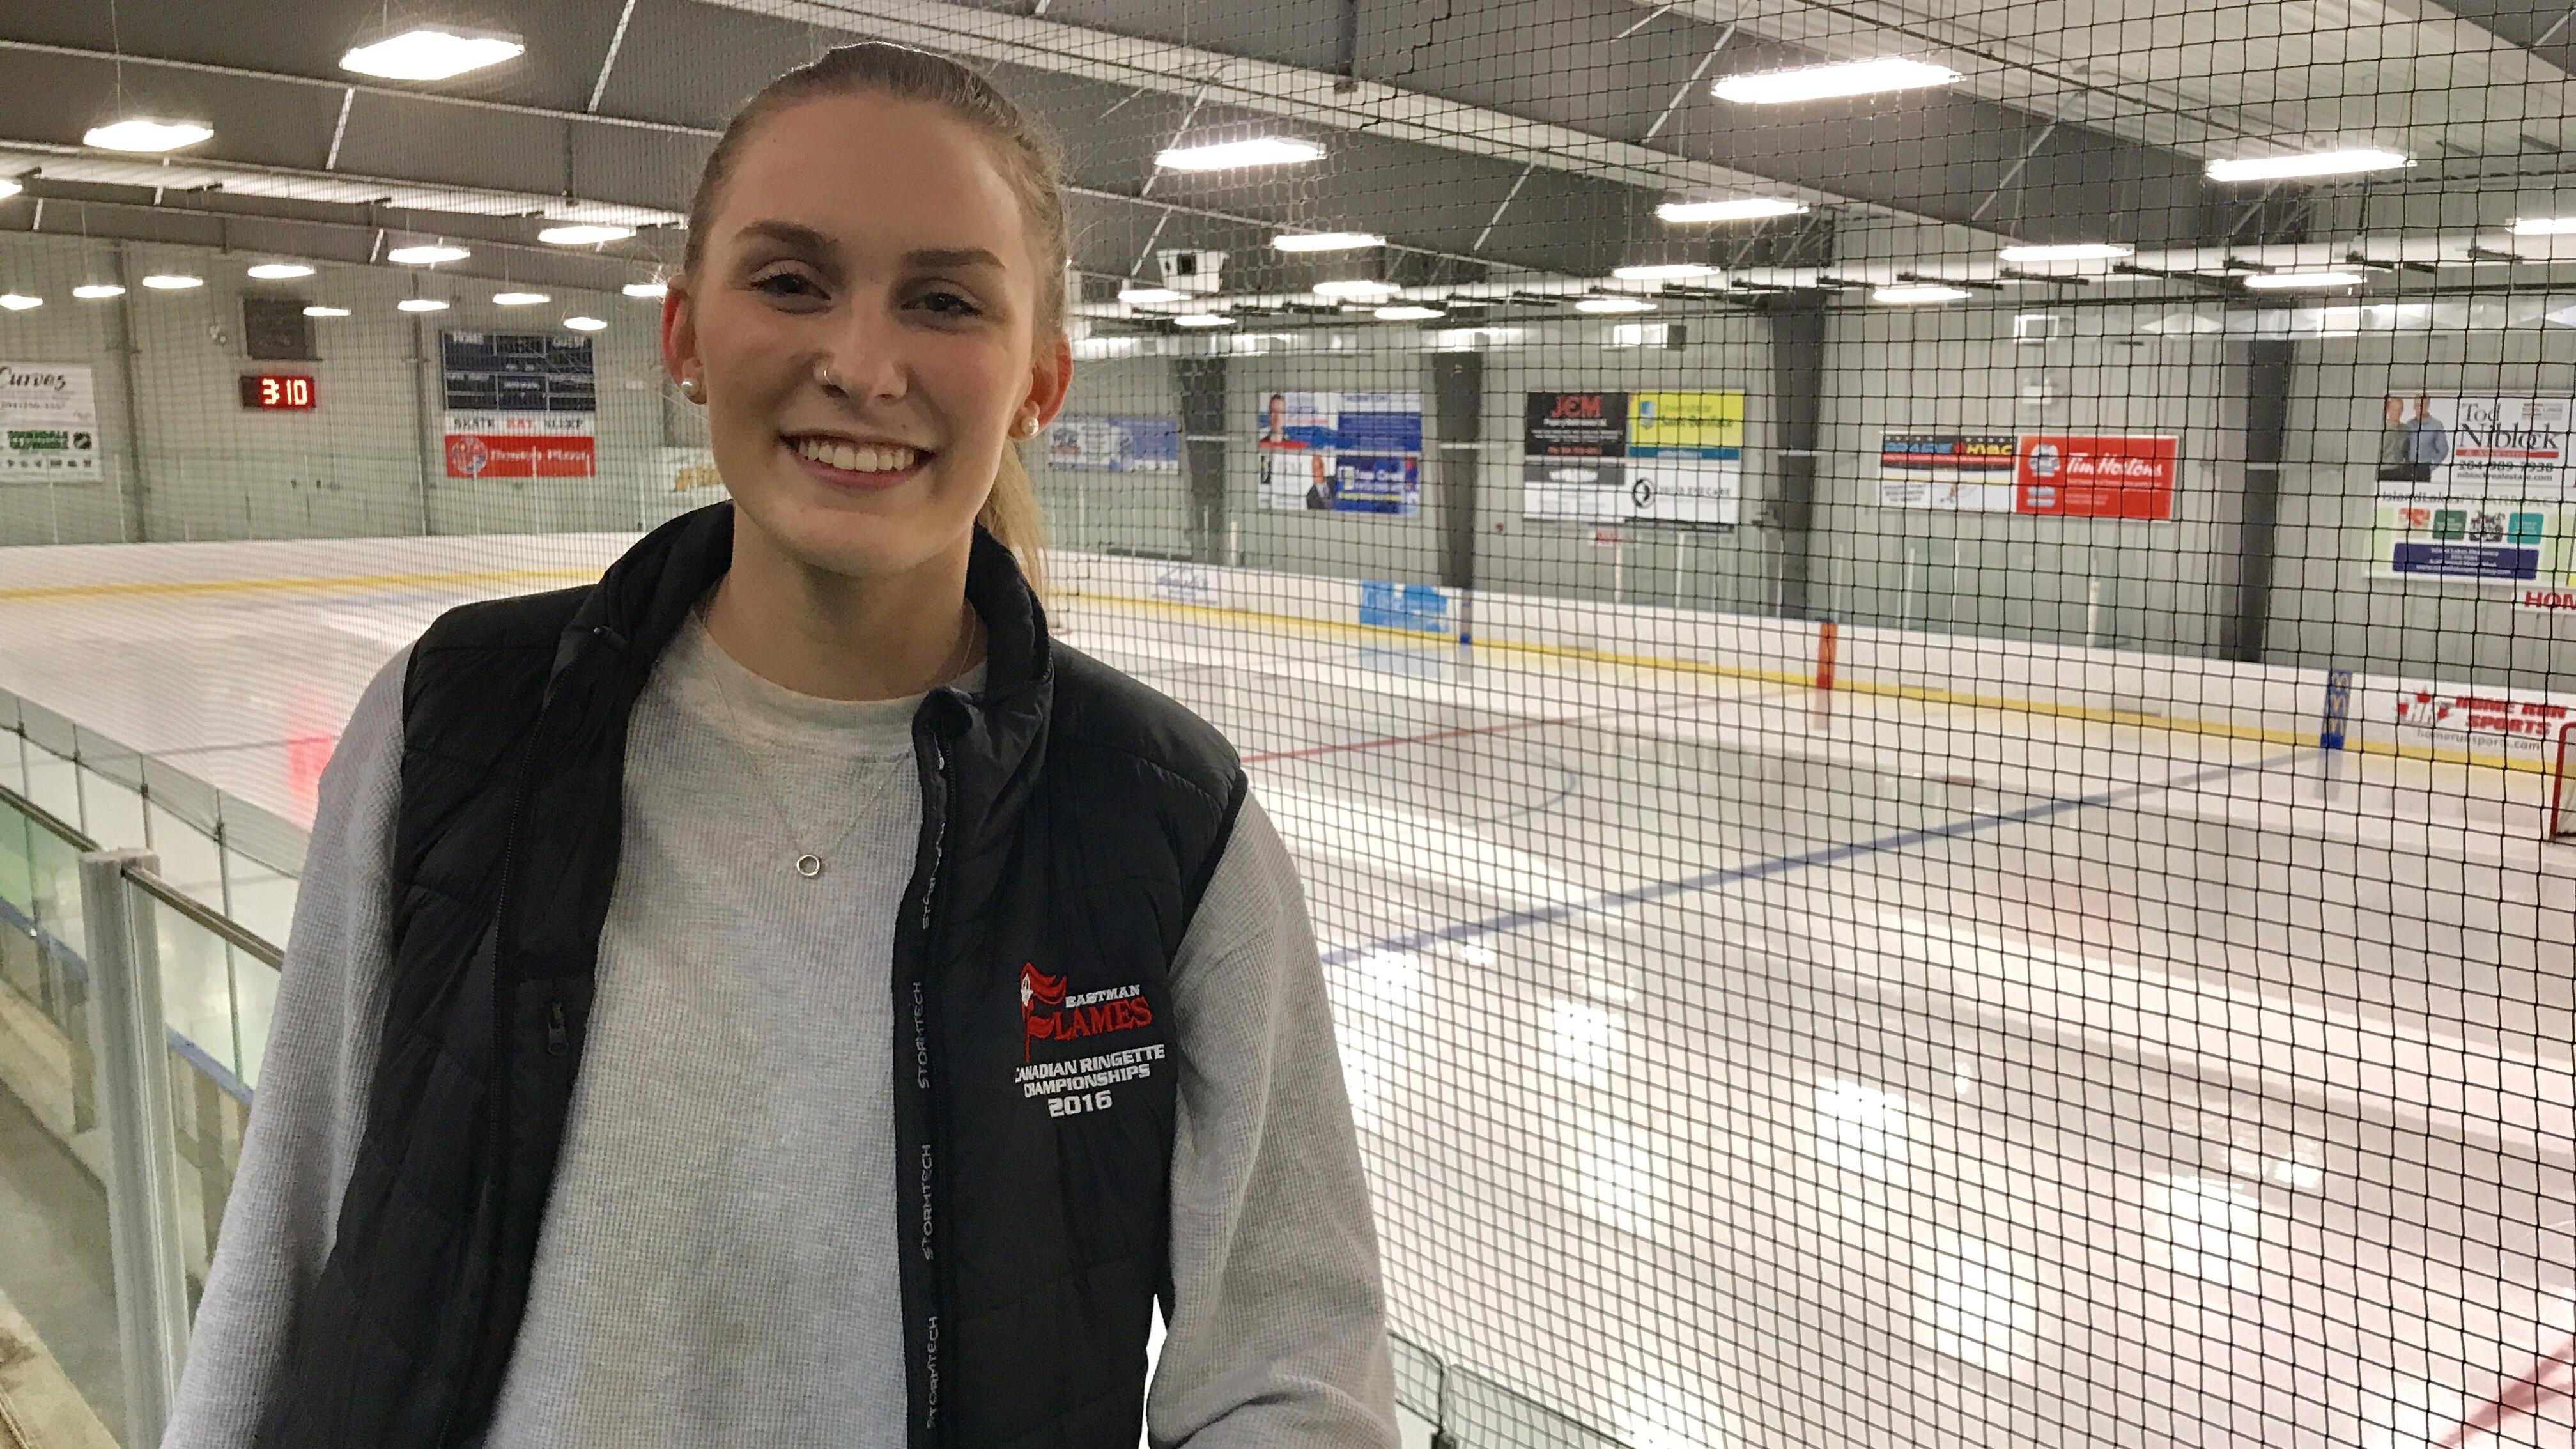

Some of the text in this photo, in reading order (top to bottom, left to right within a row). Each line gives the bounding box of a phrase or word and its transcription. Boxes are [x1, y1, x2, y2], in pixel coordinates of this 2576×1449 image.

[2462, 403, 2501, 422] Tod
[2460, 422, 2559, 449] Niblock
[2066, 452, 2095, 475] Tim
[2455, 695, 2516, 713] HOME
[2522, 702, 2568, 719] RUN
[2465, 715, 2552, 736] SPORTS
[1065, 984, 1141, 1009] EASTMAN
[913, 982, 930, 1089] STORMTECH
[1079, 1043, 1166, 1073] RINGETTE
[1023, 1063, 1151, 1099] CHAMPIONSHIPS
[1047, 1089, 1113, 1119] 2016
[922, 1144, 934, 1260] STORMTECH
[927, 1316, 939, 1432] STORMTECH
